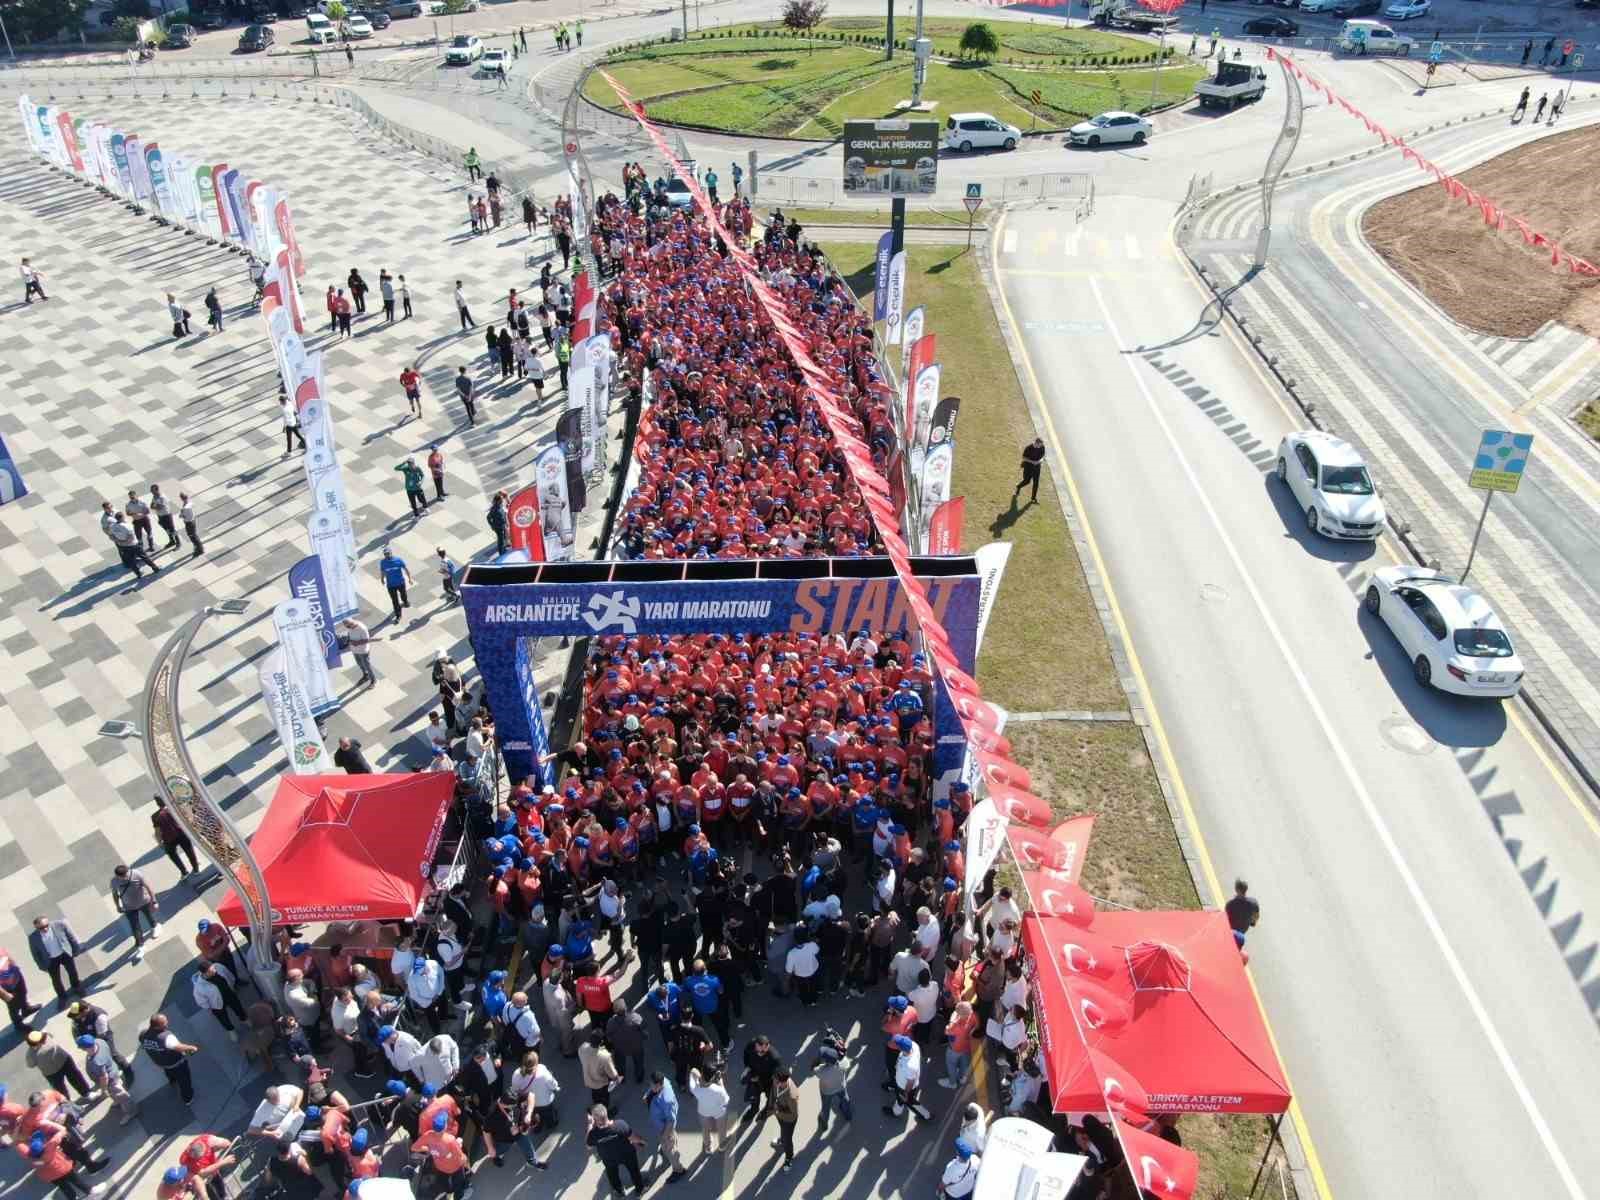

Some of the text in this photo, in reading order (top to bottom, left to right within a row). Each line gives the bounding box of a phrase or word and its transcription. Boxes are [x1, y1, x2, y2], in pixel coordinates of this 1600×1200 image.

[850, 140, 890, 151] GENÇLİK
[485, 604, 580, 622] ARSLANTEPE
[643, 601, 771, 620] YARI MARATONU
[790, 578, 961, 632] START
[1148, 1103, 1221, 1111] EDERASYONU
